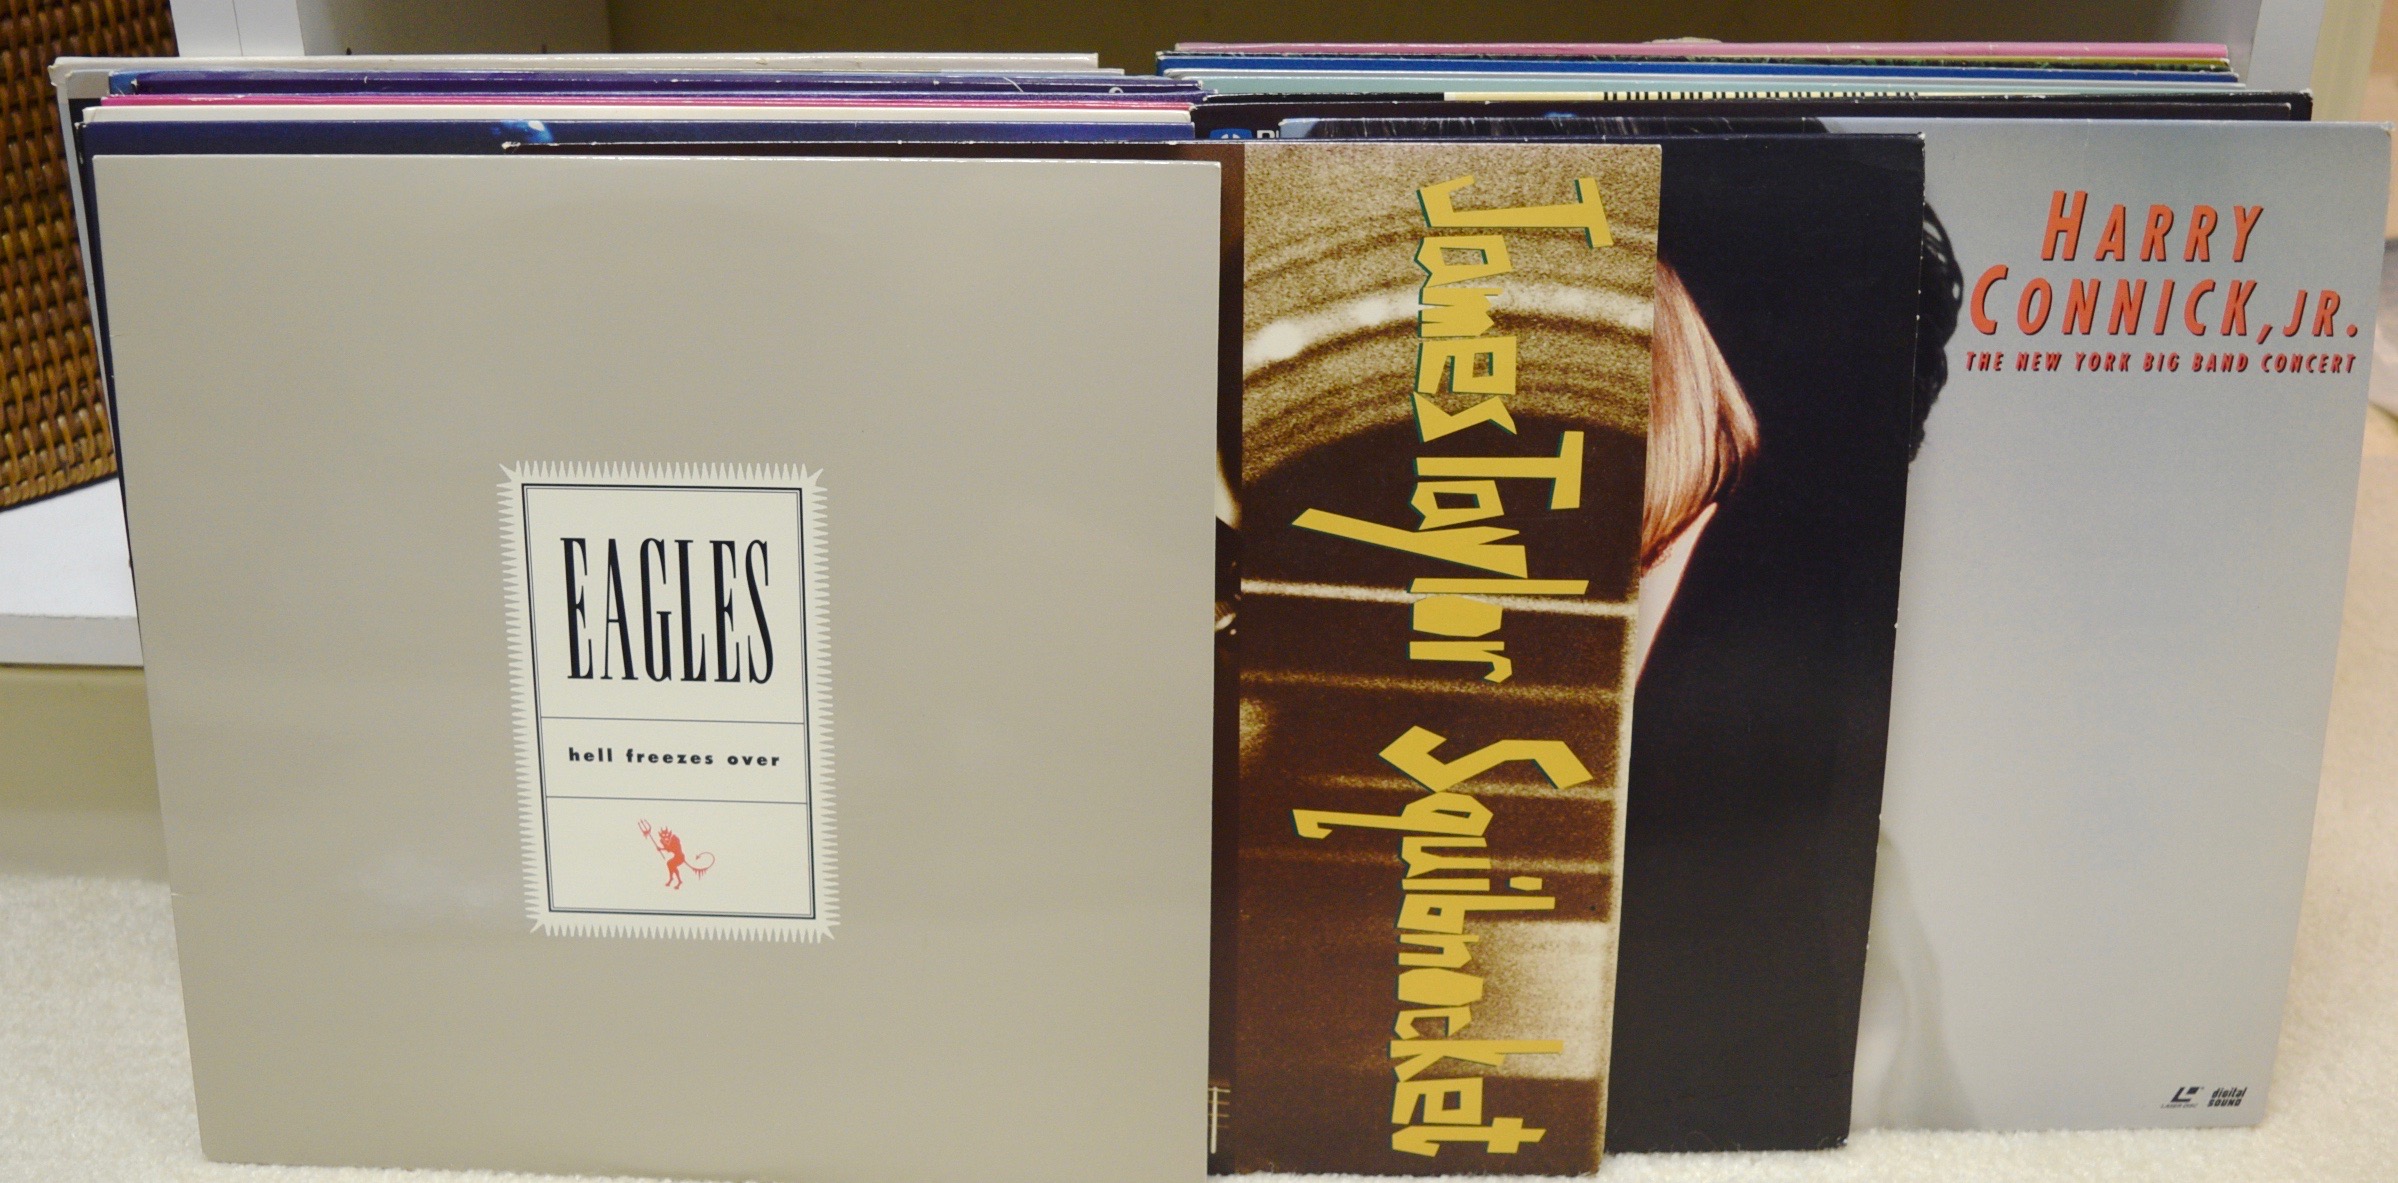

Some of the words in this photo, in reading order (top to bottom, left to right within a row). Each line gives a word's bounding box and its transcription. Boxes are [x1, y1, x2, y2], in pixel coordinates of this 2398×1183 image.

[2041, 190, 2264, 263] HARRY
[1413, 175, 1614, 442] James
[1966, 351, 2003, 372] THE
[2015, 351, 2062, 372] NEW
[2075, 351, 2131, 372] YORK
[2143, 351, 2180, 373] BIG
[2192, 352, 2249, 373] BAND
[2261, 352, 2357, 374] CONCERT
[560, 537, 774, 684] EAGLES
[1291, 431, 1590, 684] Taylor
[568, 747, 613, 763] hell
[626, 748, 714, 765] freezes
[727, 755, 780, 767] over
[1293, 725, 1594, 1158] Squibnocket
